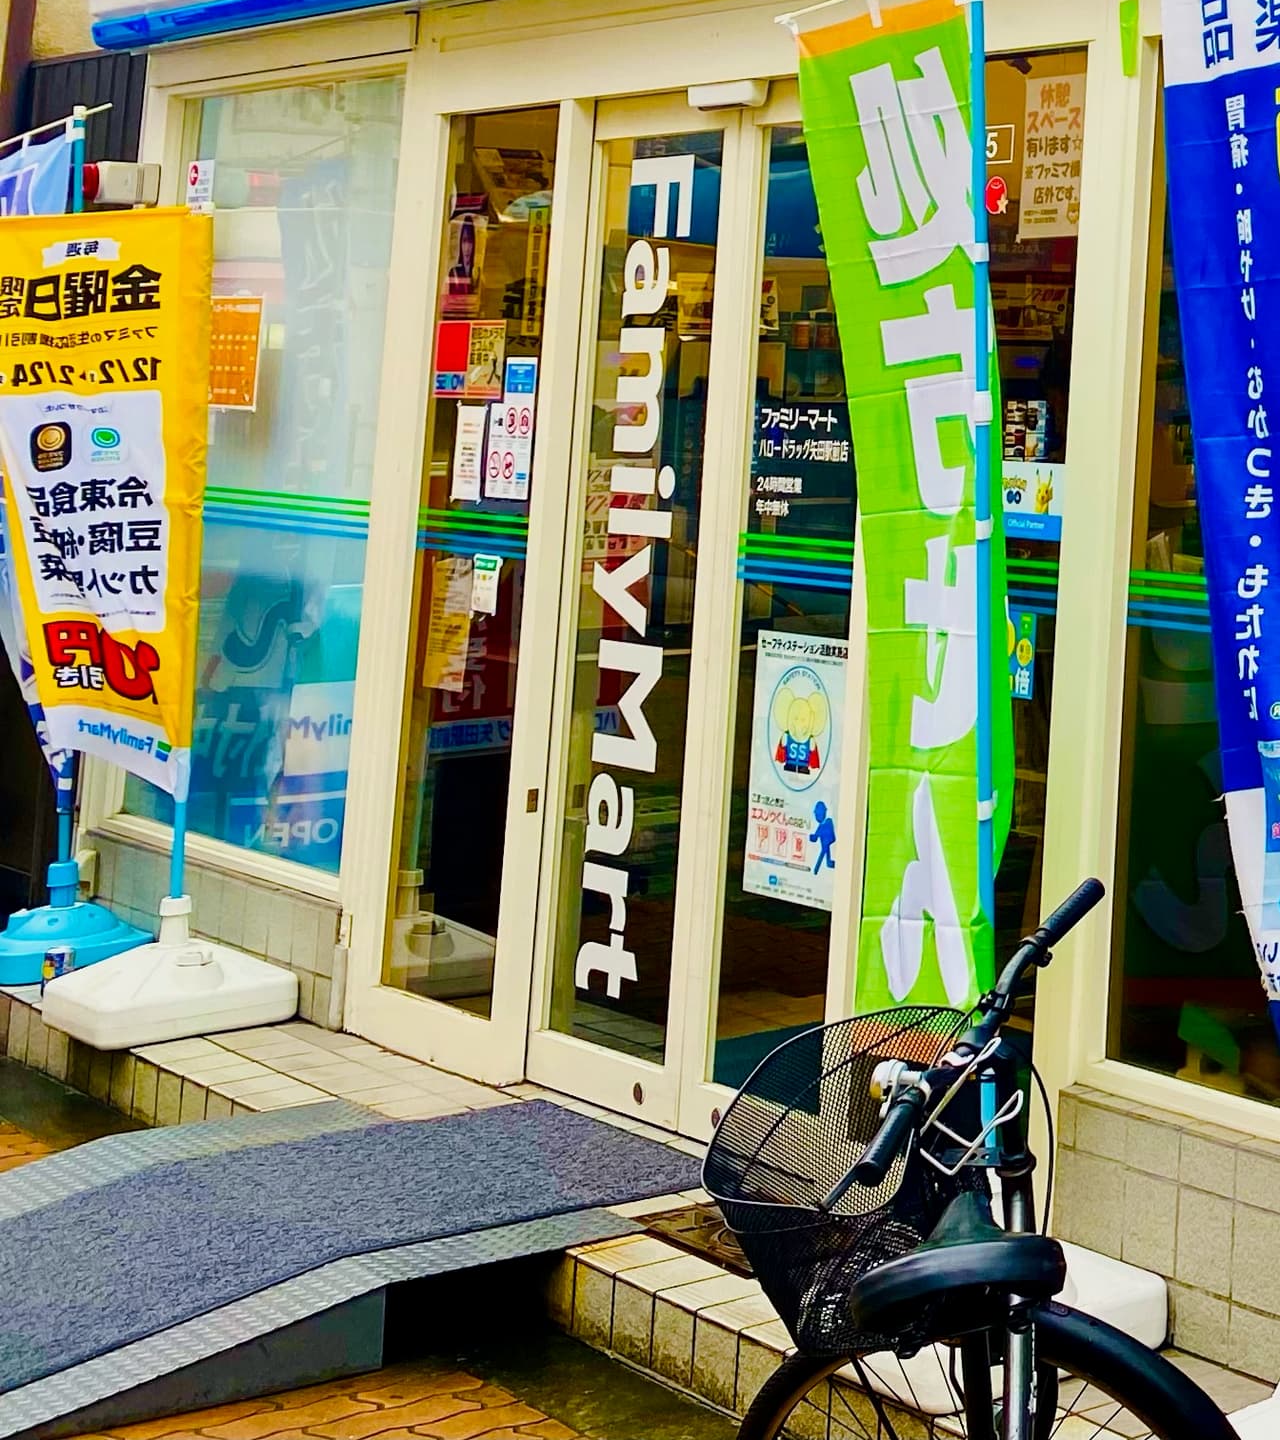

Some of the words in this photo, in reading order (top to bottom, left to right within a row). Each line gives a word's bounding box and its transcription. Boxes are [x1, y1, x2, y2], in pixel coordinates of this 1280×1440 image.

[575, 155, 695, 1000] FamilyMart
[761, 407, 838, 432] ファミリーマート
